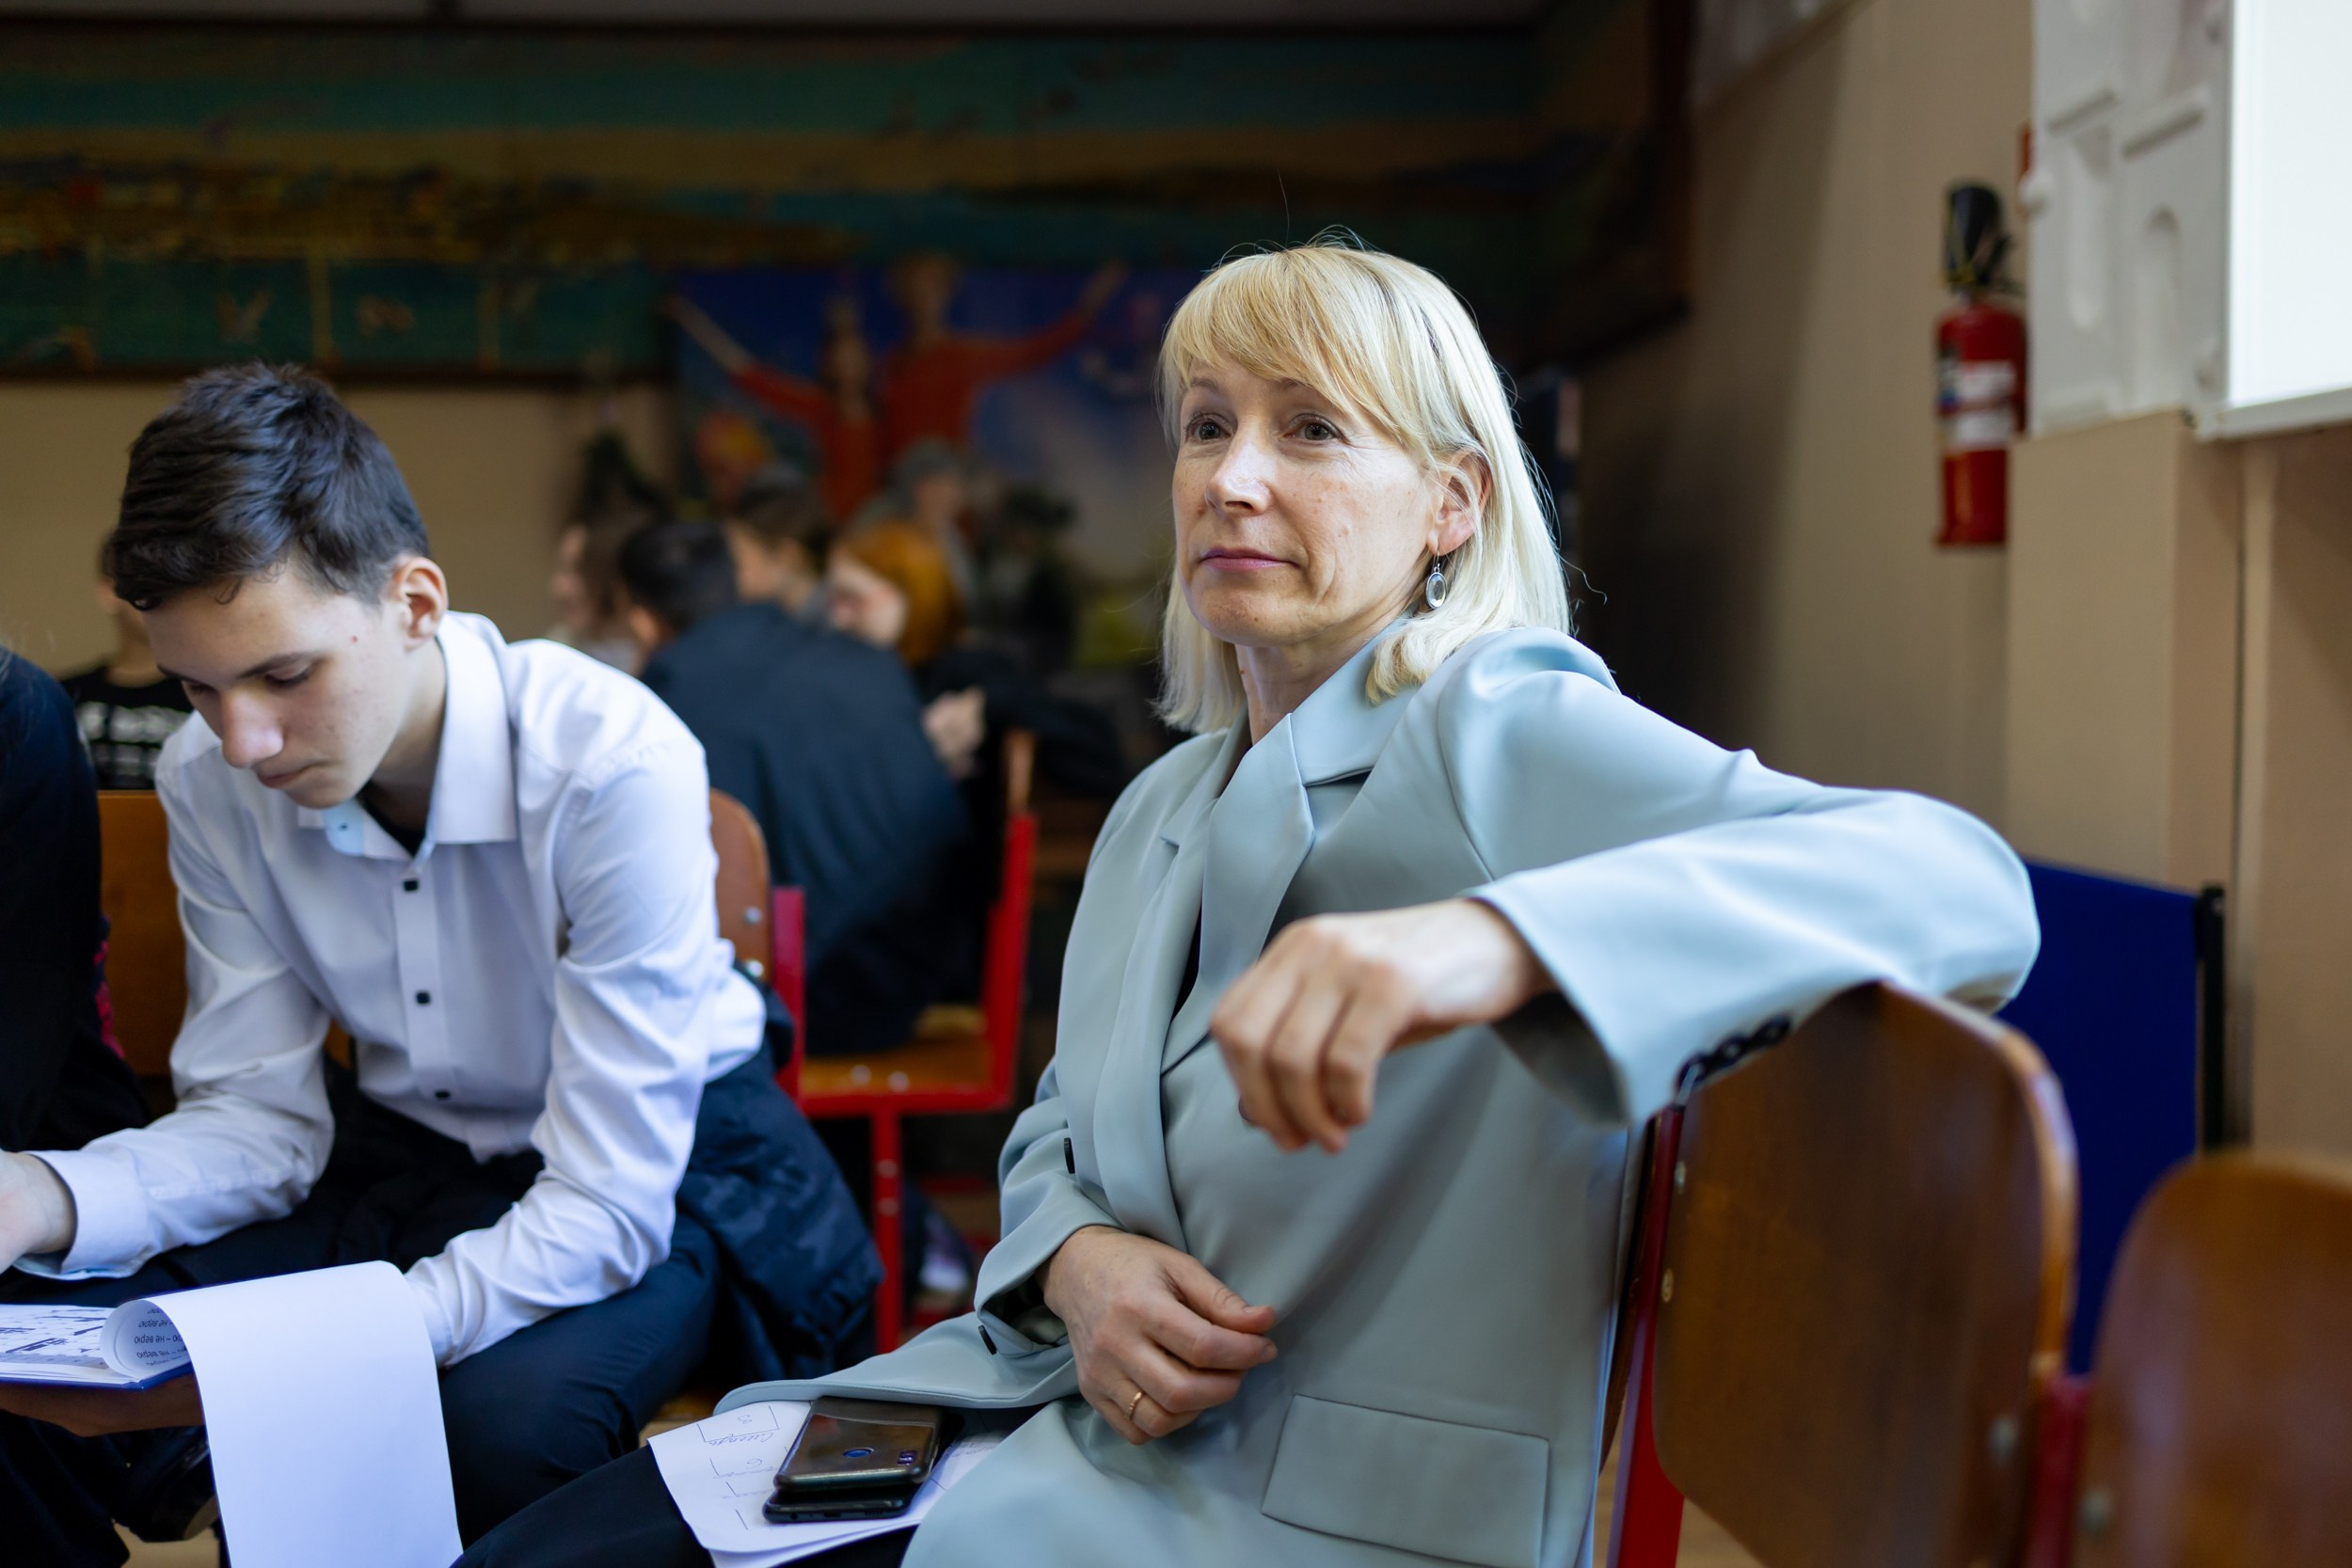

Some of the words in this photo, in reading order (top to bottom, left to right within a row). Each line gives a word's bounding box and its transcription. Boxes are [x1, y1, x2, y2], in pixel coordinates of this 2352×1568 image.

[138, 1319, 159, 1327] верю
[134, 1334, 154, 1344] верю
[155, 1335, 165, 1343] не
[136, 1350, 159, 1358] верю
